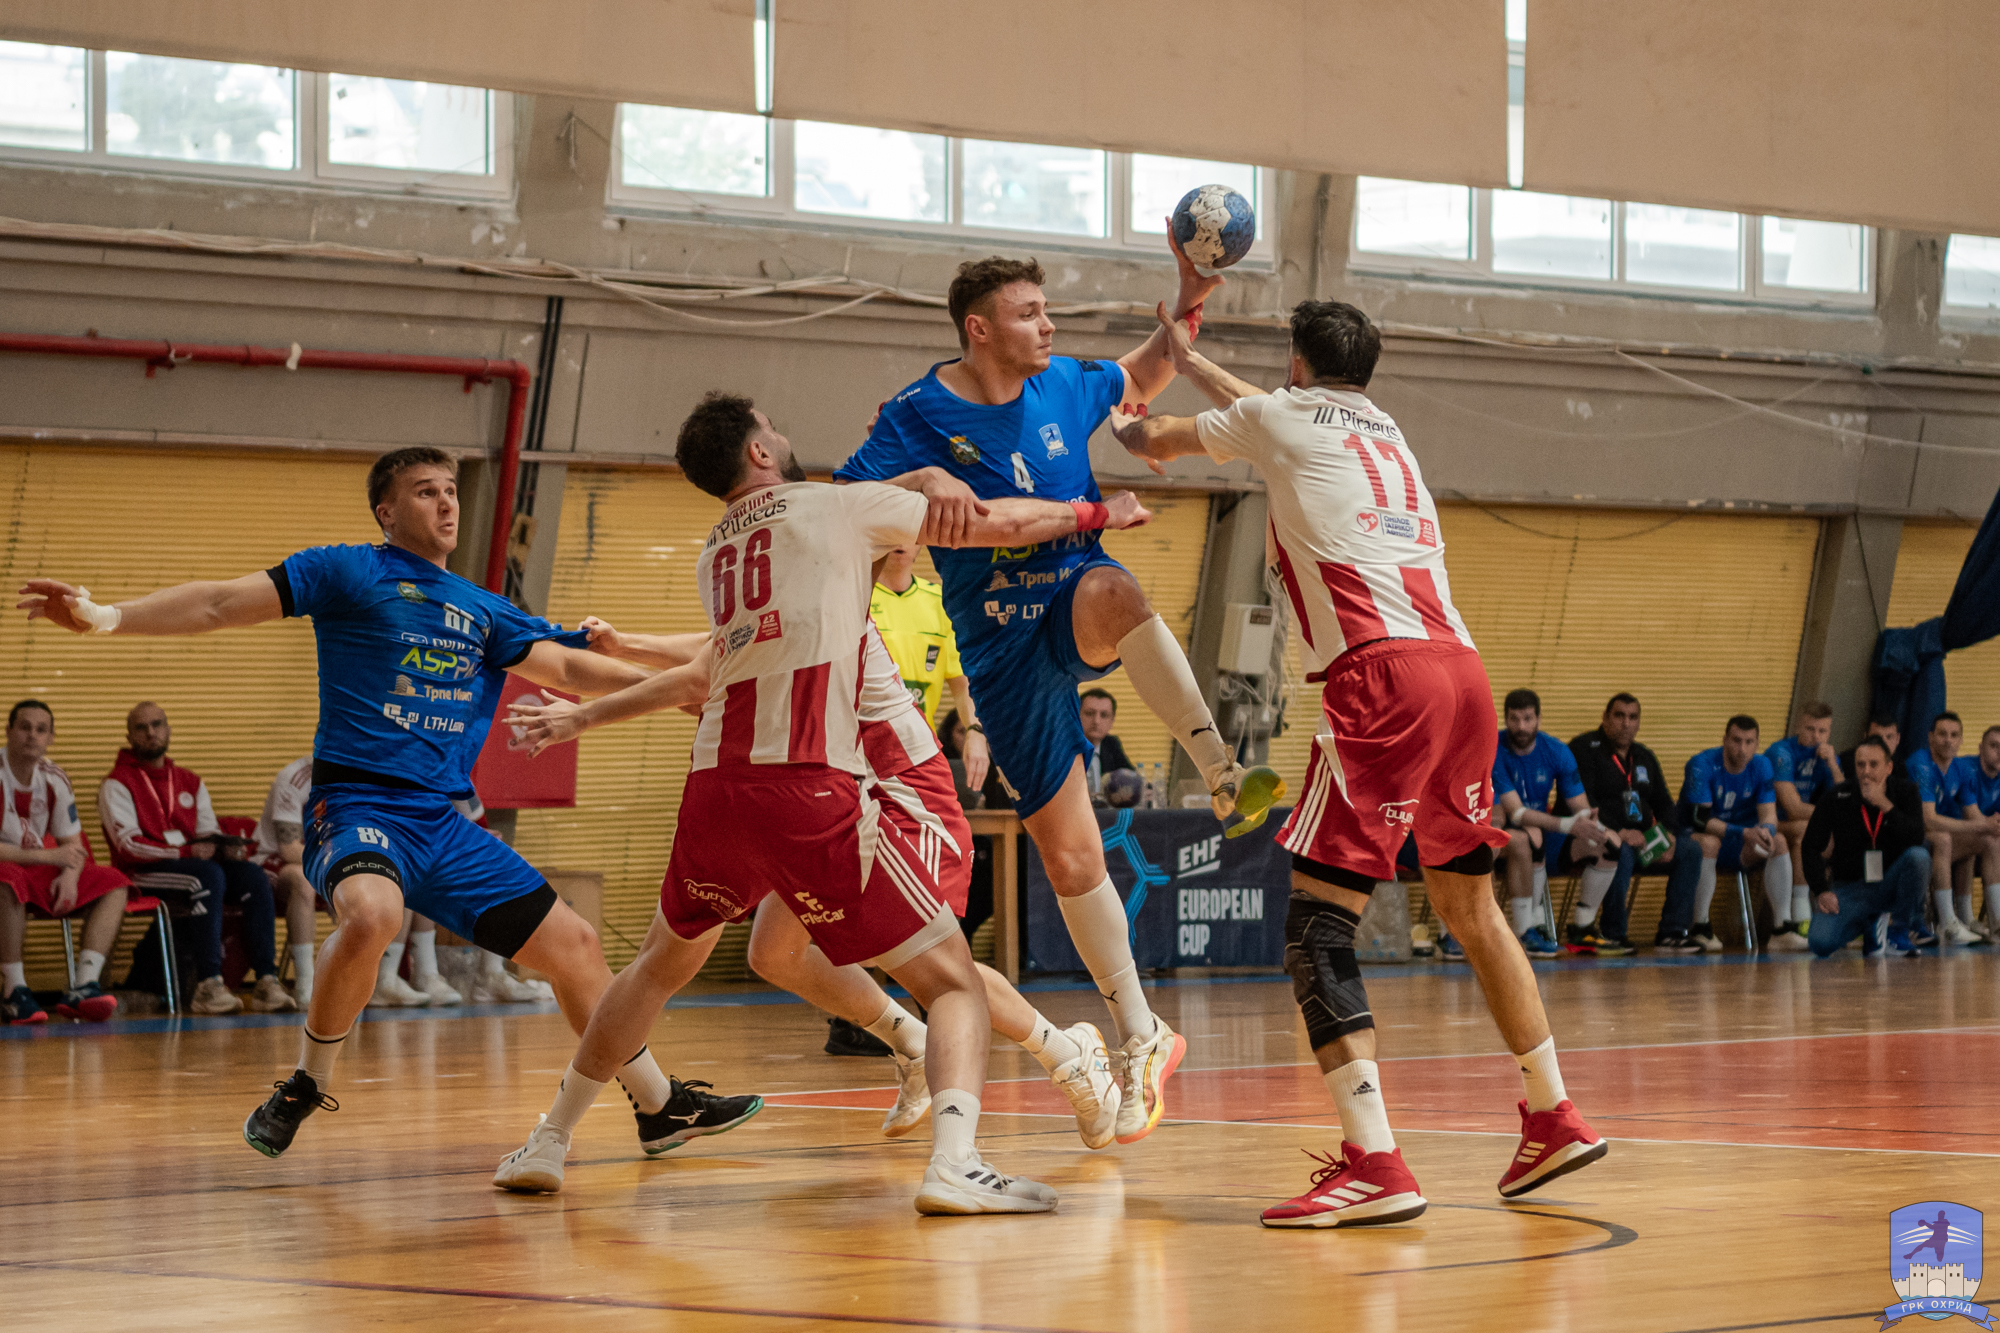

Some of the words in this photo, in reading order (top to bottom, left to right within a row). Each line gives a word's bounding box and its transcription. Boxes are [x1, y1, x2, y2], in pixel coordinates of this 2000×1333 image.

[1339, 408, 1400, 441] Piraeus
[1010, 452, 1035, 494] 4
[1342, 433, 1419, 513] 17
[712, 528, 772, 627] 66
[1016, 571, 1056, 589] Трпе
[424, 685, 452, 702] Трпе
[424, 715, 448, 731] LTH
[996, 766, 1021, 801] 4
[356, 827, 389, 850] 87
[1179, 834, 1222, 872] EHF
[1178, 887, 1264, 920] EUROPEAN
[1178, 923, 1211, 956] CUP
